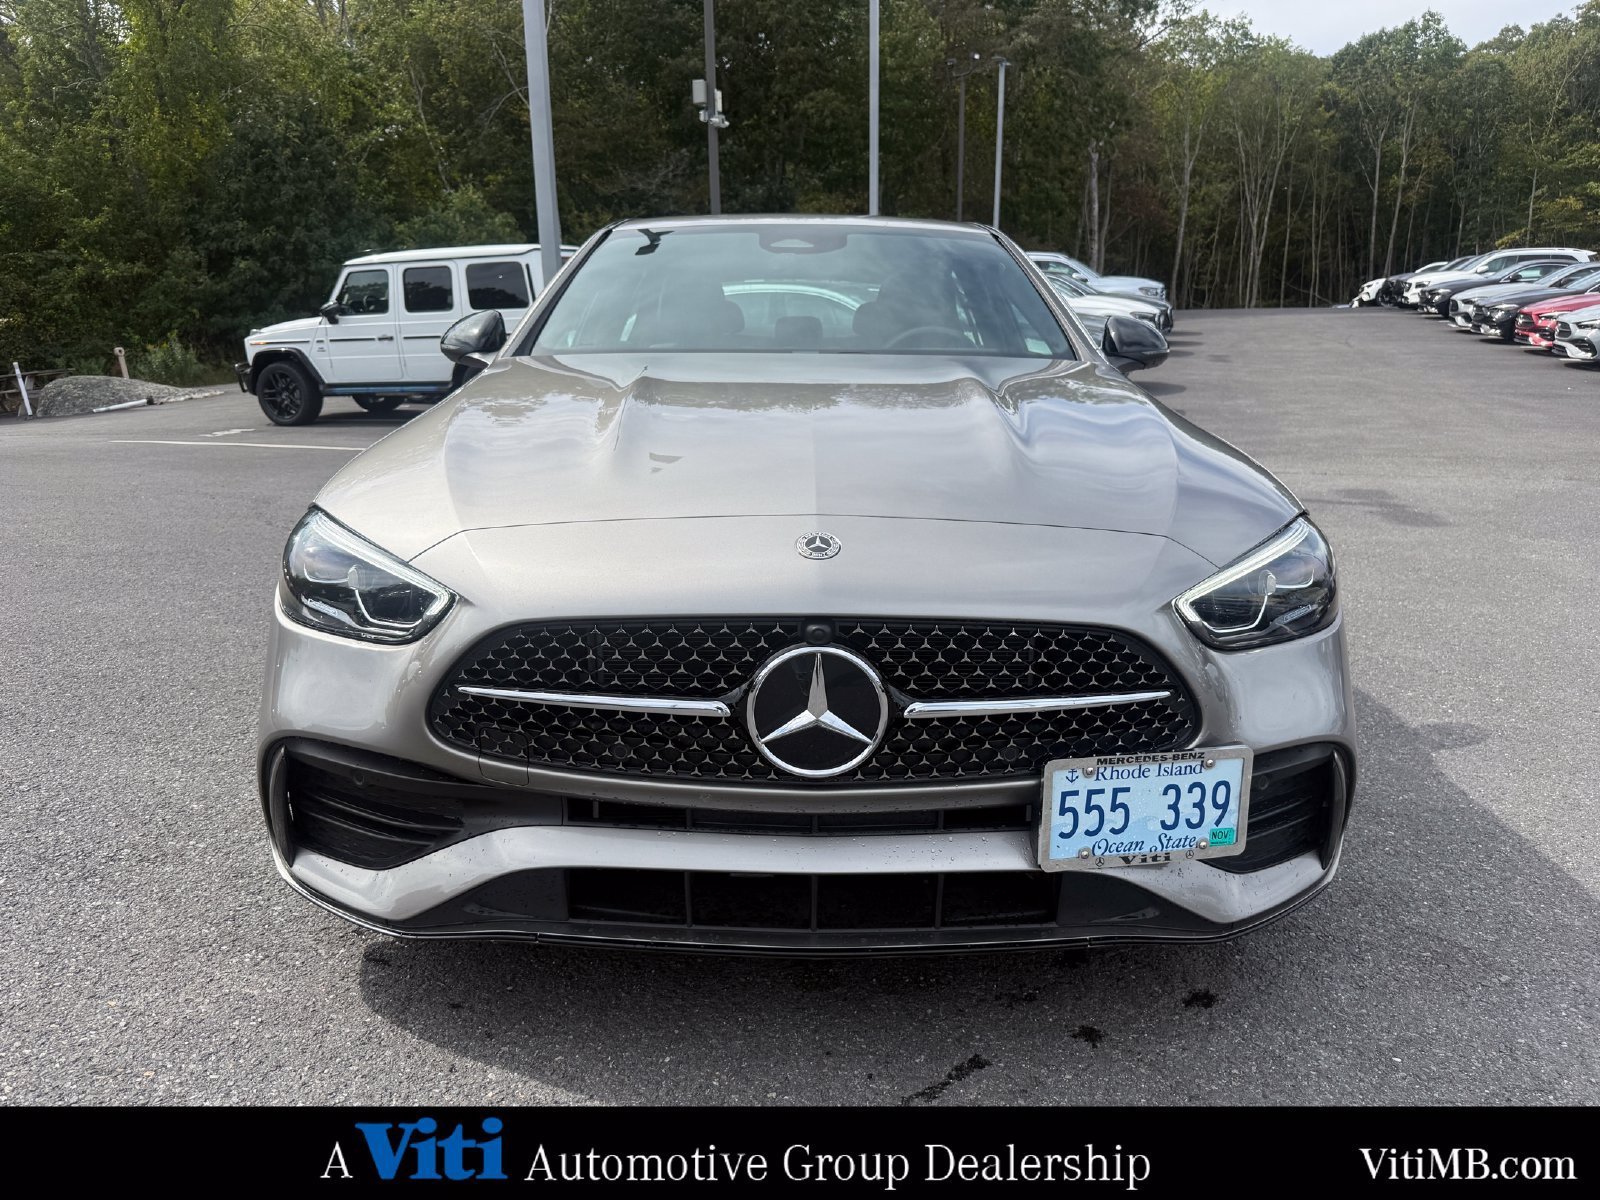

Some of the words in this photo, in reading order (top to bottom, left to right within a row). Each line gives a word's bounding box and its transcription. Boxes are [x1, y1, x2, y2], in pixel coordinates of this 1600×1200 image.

[1096, 752, 1206, 766] MERCEDES-BENZ
[1094, 765, 1151, 782] Rhode
[1157, 760, 1205, 778] Island
[1058, 786, 1131, 839] 555
[1160, 780, 1231, 831] 339
[1211, 830, 1229, 840] NOV
[1091, 838, 1145, 857] Ocean
[1149, 832, 1197, 853] State
[1119, 852, 1171, 865] Viti
